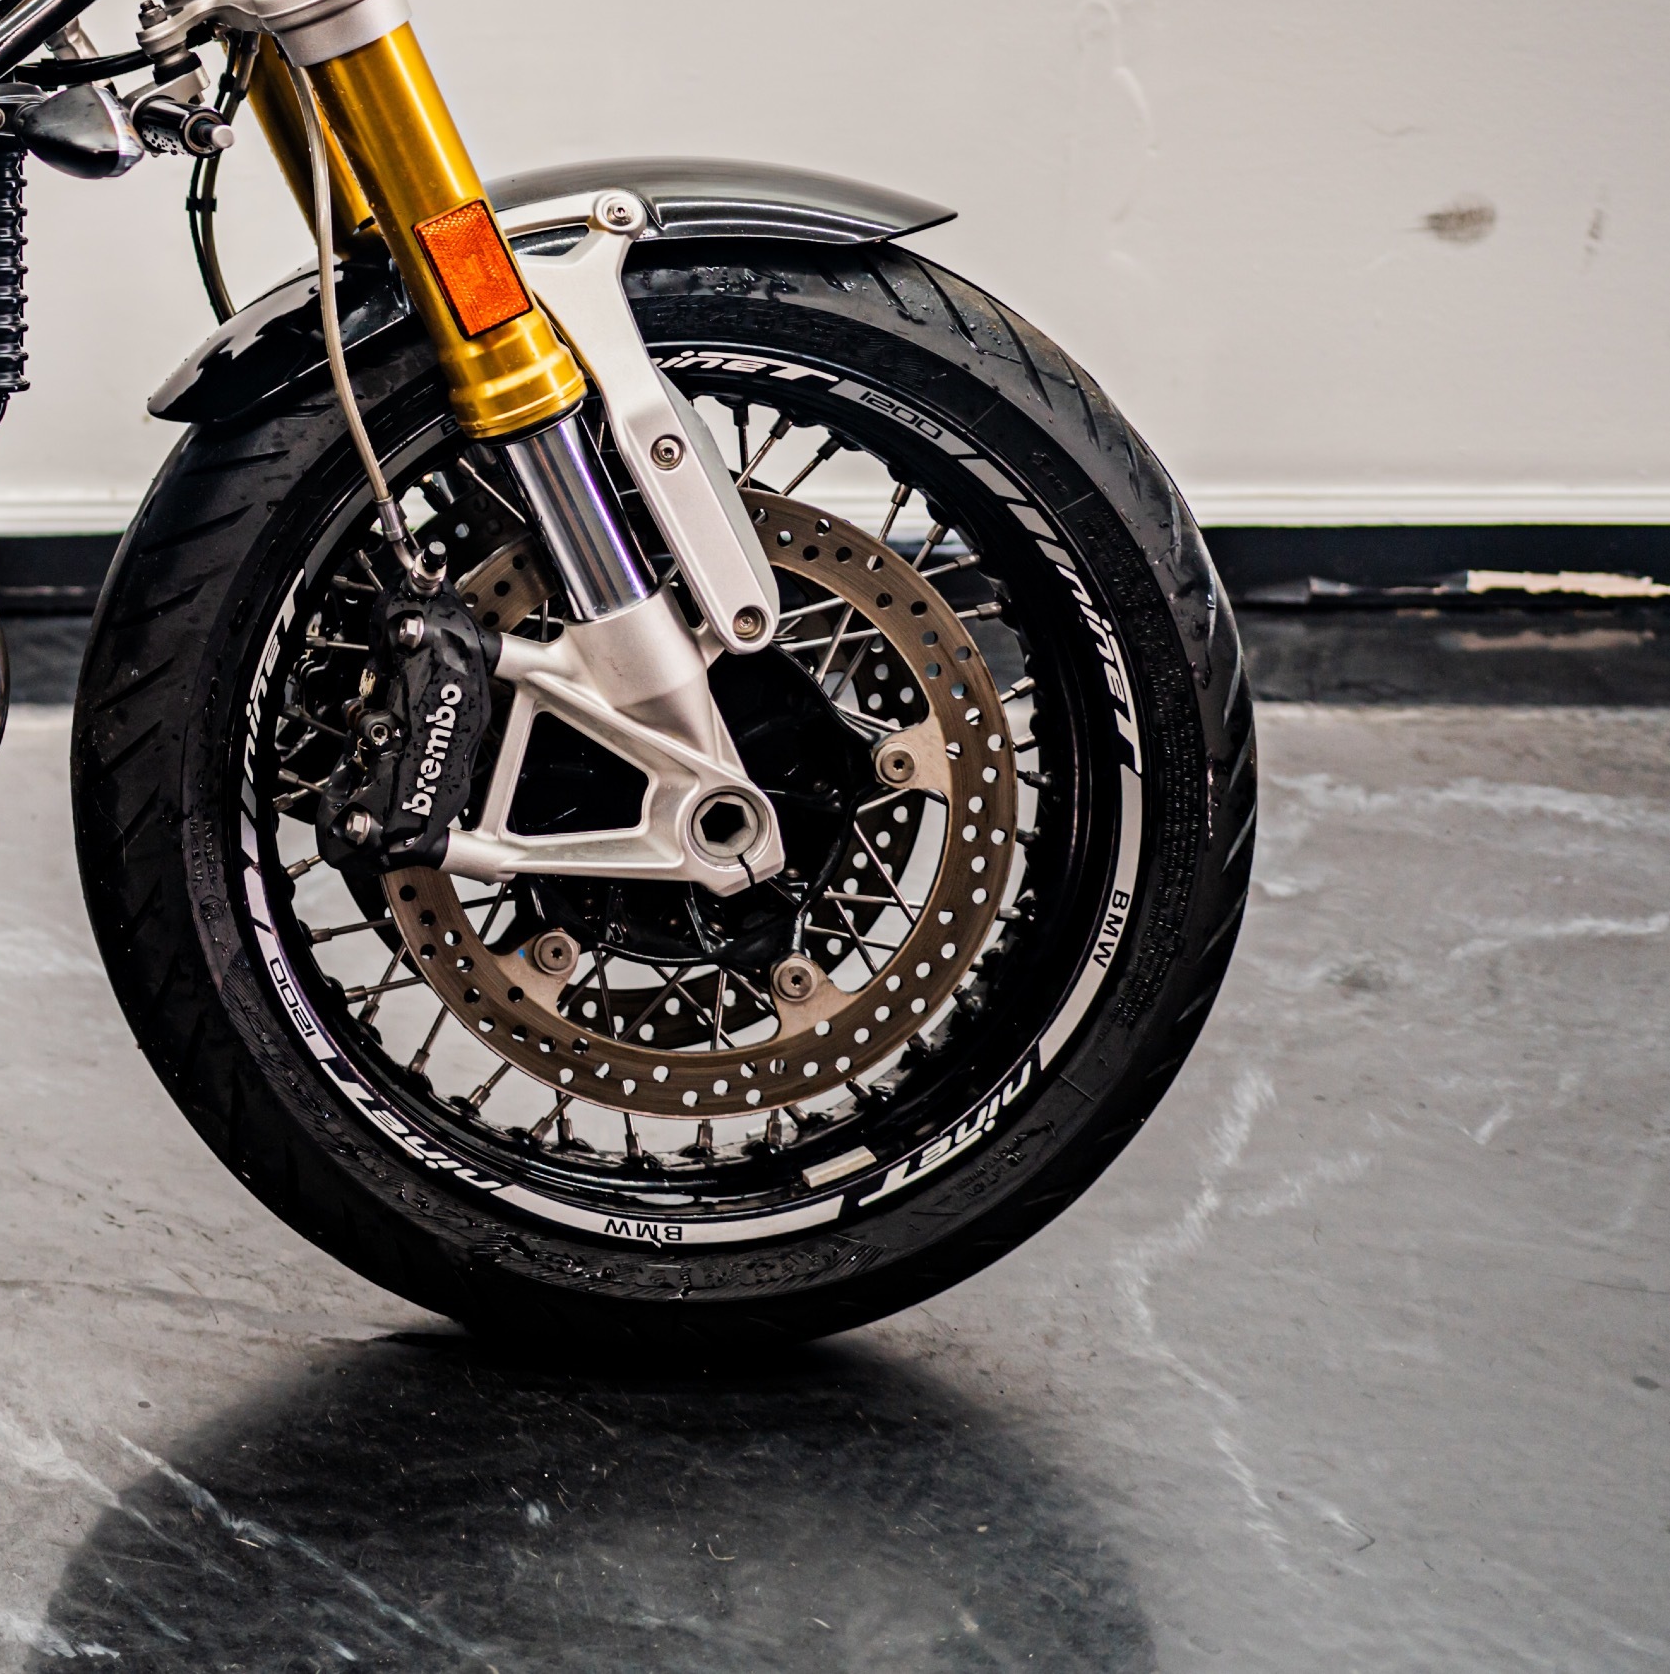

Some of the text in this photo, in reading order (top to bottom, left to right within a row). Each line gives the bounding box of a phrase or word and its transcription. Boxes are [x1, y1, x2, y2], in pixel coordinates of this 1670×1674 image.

[859, 391, 943, 440] 1200
[243, 568, 305, 784] nineT
[1057, 564, 1142, 774] nineT
[402, 683, 462, 816] brembo
[1093, 889, 1130, 969] BMW
[269, 957, 316, 1038] 1200
[320, 1062, 501, 1189] nineT
[858, 1060, 1032, 1207] nineT
[605, 1218, 682, 1242] BMW
